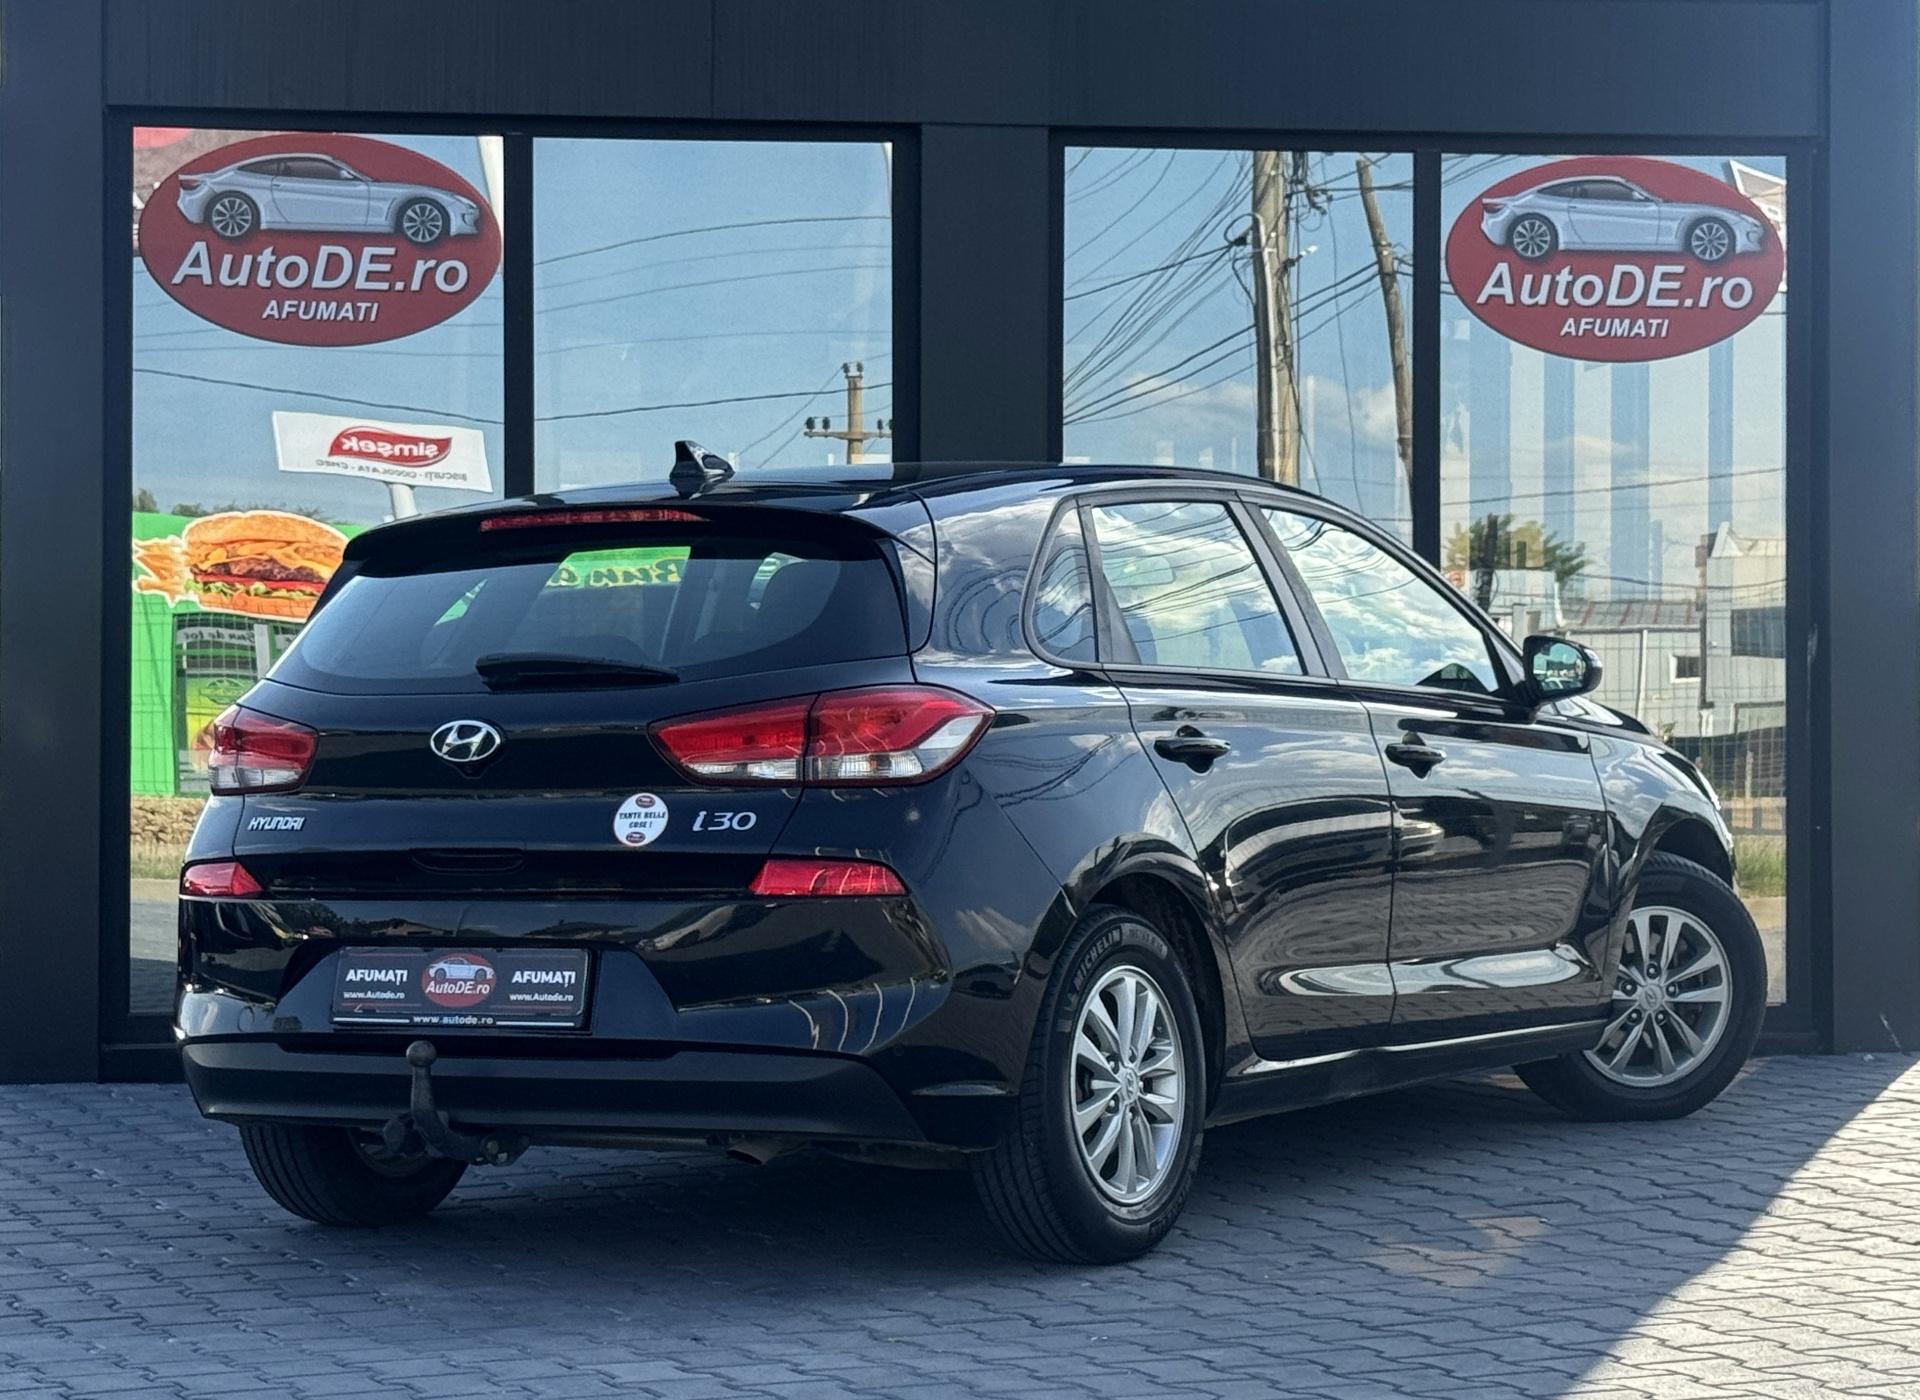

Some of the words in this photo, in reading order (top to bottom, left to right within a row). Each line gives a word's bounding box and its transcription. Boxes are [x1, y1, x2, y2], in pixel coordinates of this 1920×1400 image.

[171, 240, 470, 293] AutoDE.ro
[1476, 262, 1754, 309] AutoDE.ro
[262, 300, 380, 322] AFUMATI
[1560, 317, 1670, 338] AFUMATI
[247, 816, 305, 830] HYUNDAI
[692, 811, 757, 831] i30
[1074, 928, 1121, 991] MICHELIN
[425, 980, 491, 995] AutoDE.ro
